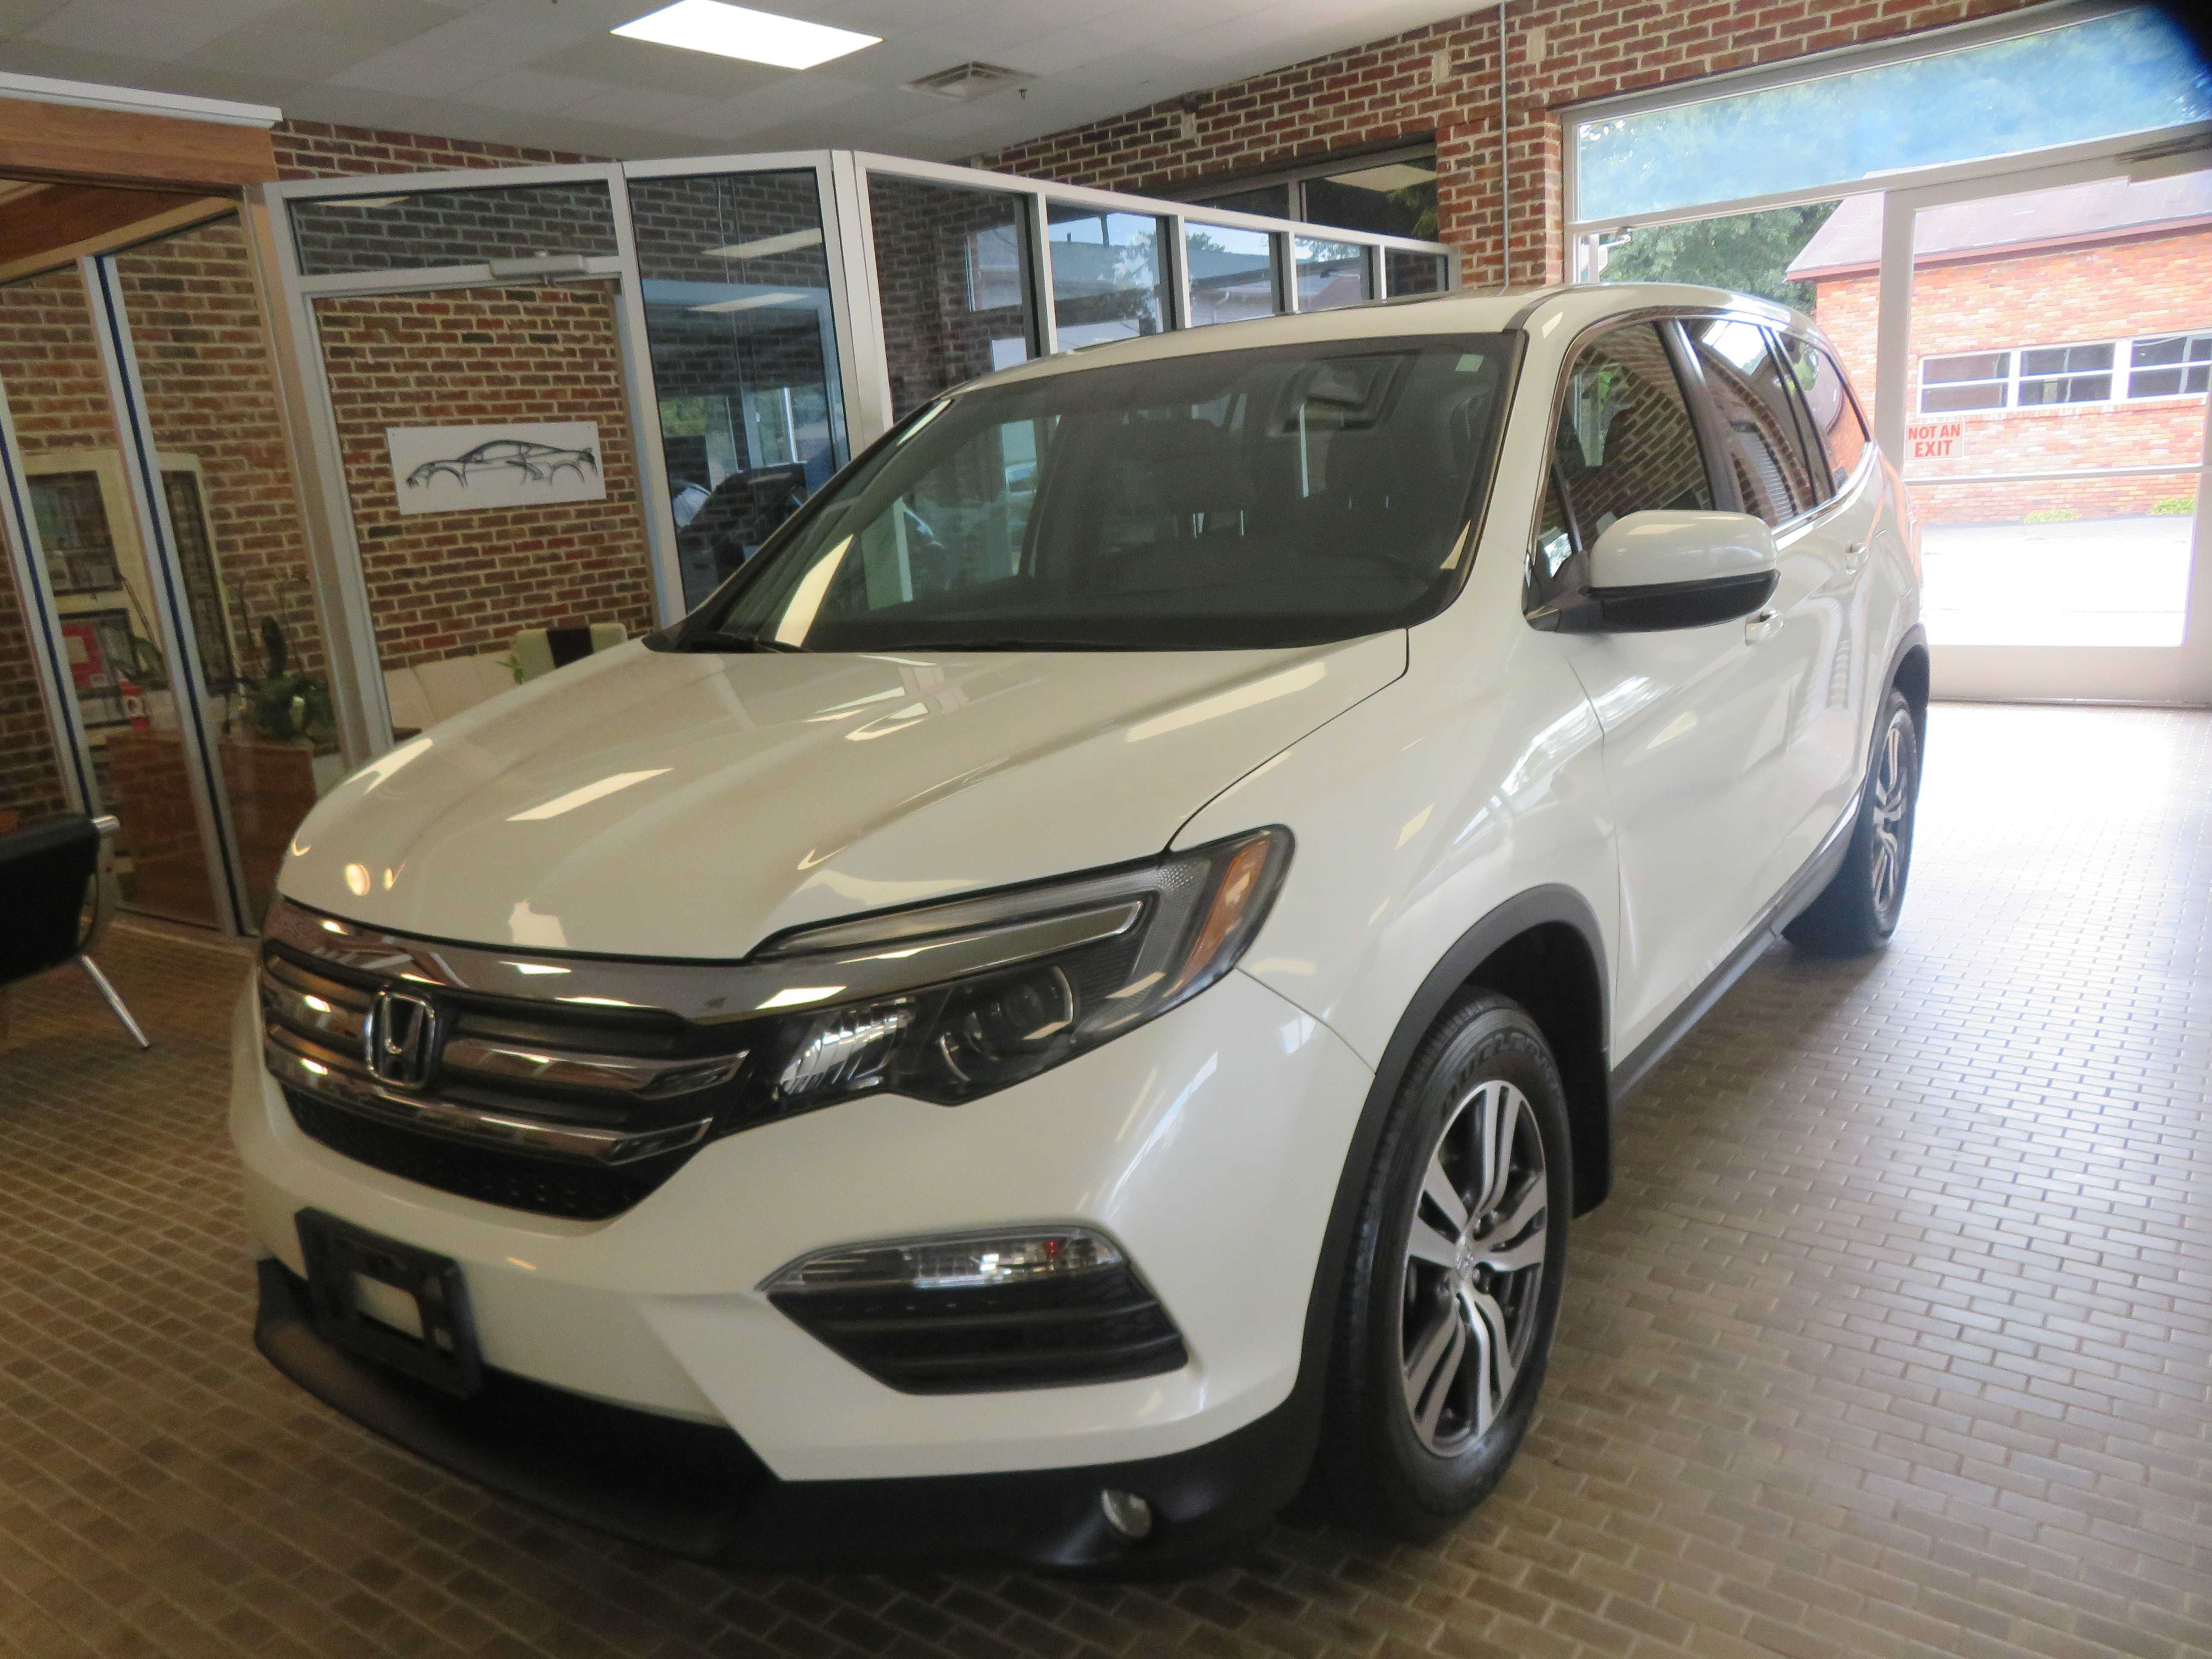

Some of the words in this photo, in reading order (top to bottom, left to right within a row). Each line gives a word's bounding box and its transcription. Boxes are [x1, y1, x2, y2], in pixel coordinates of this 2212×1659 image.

[1909, 425, 1937, 439] NOT
[1940, 424, 1960, 437] AN
[1915, 440, 1952, 457] EXIT
